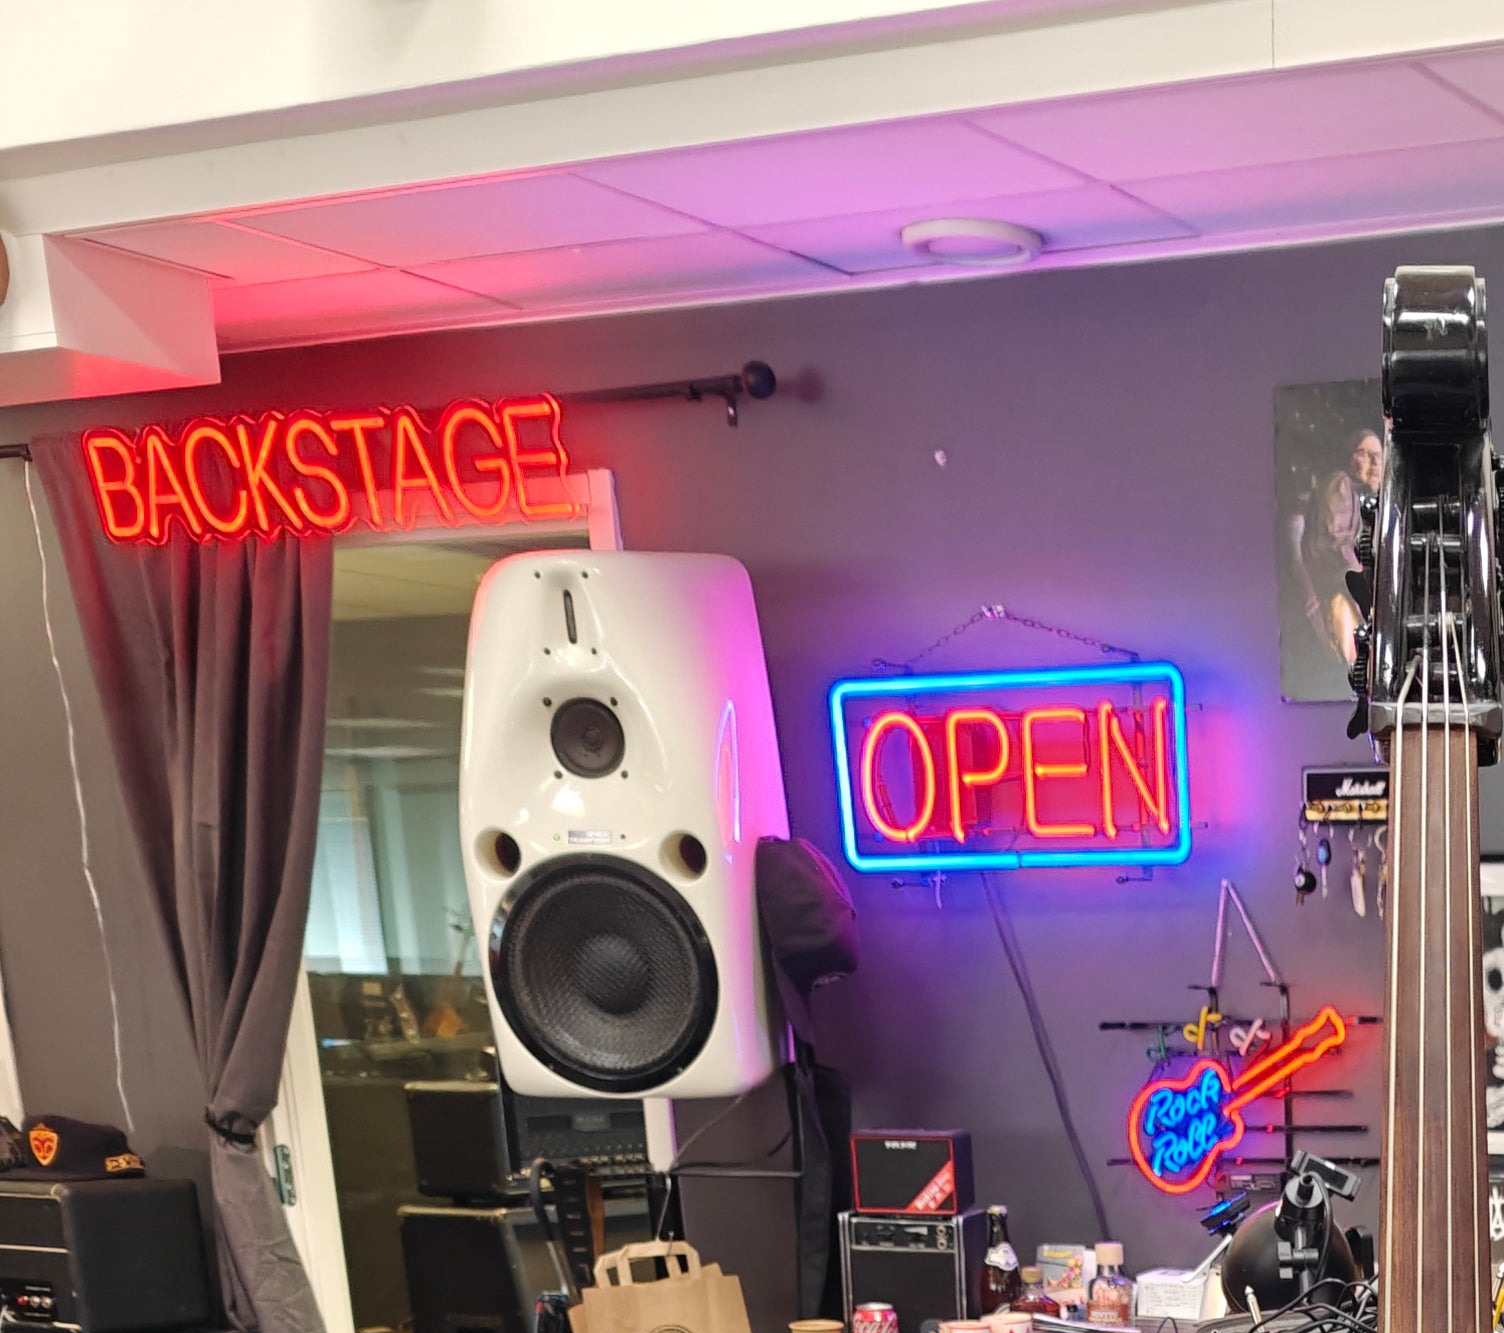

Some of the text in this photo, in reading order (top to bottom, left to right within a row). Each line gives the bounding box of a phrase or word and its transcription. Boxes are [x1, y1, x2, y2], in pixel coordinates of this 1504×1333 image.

[86, 402, 575, 537] BACKSTAGE
[862, 699, 1169, 842] OPEN
[1145, 1068, 1220, 1135] Rock
[1152, 1112, 1219, 1176] Roll
